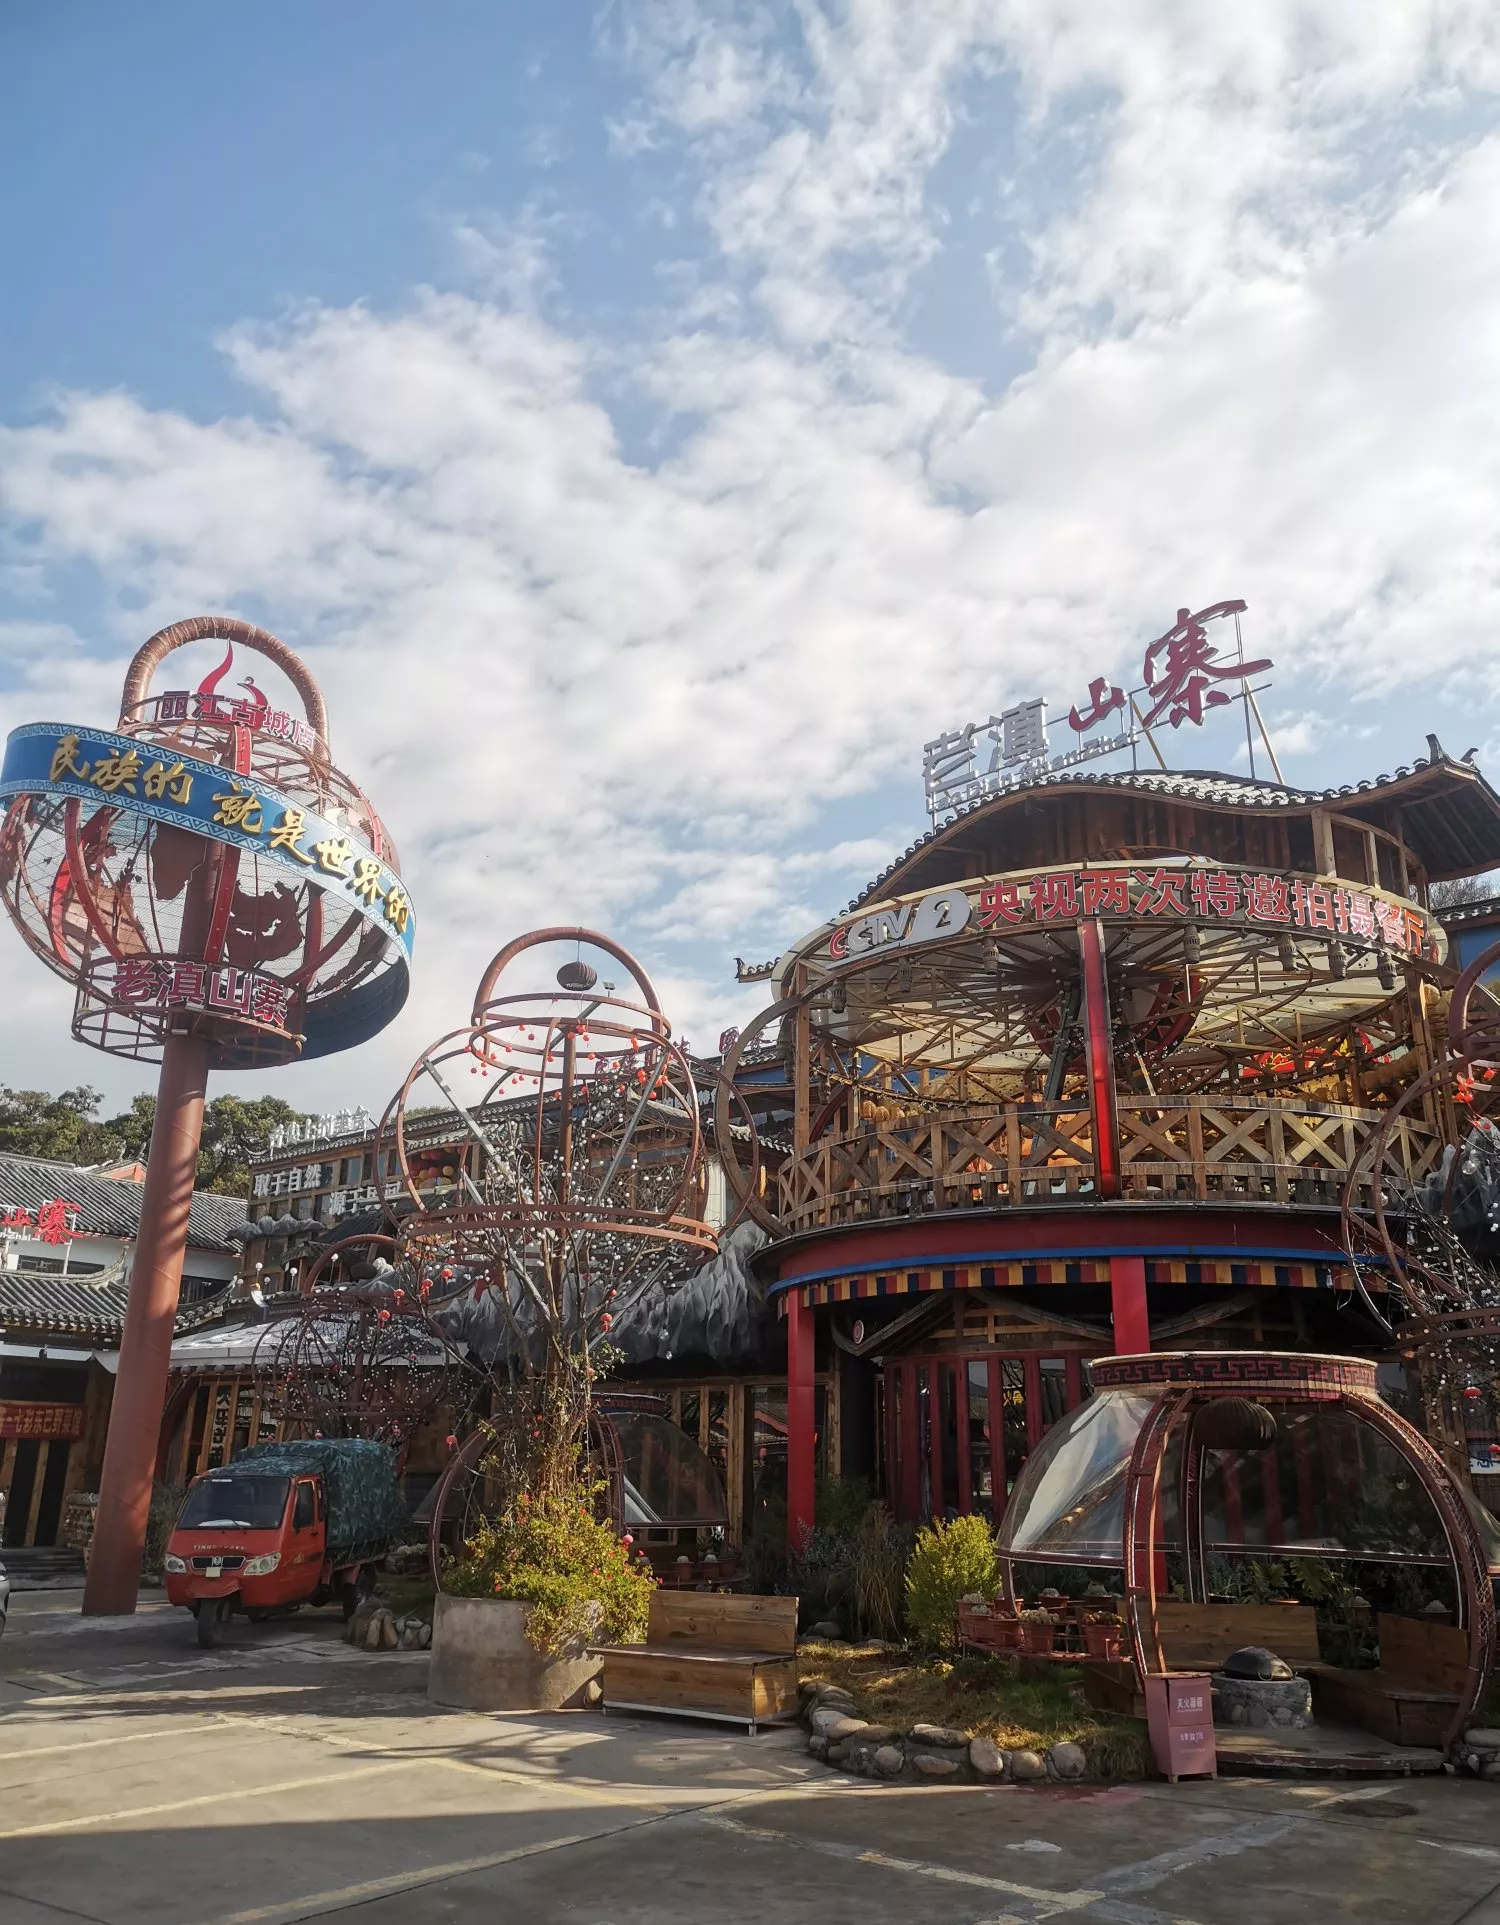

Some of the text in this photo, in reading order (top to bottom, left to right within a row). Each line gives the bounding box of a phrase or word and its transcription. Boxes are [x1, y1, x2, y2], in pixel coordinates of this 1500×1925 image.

[160, 691, 316, 751] 丽江古城店
[922, 598, 1274, 797] 老滇山寨
[1082, 726, 1138, 760] Zhai
[49, 734, 410, 934] 民族的 就是世界的
[977, 868, 1425, 956] 央视两次特邀拍摄餐厅
[112, 959, 289, 1025] 老滇山寨
[253, 1163, 322, 1198] 取于自然
[4, 1196, 84, 1246] 山寨
